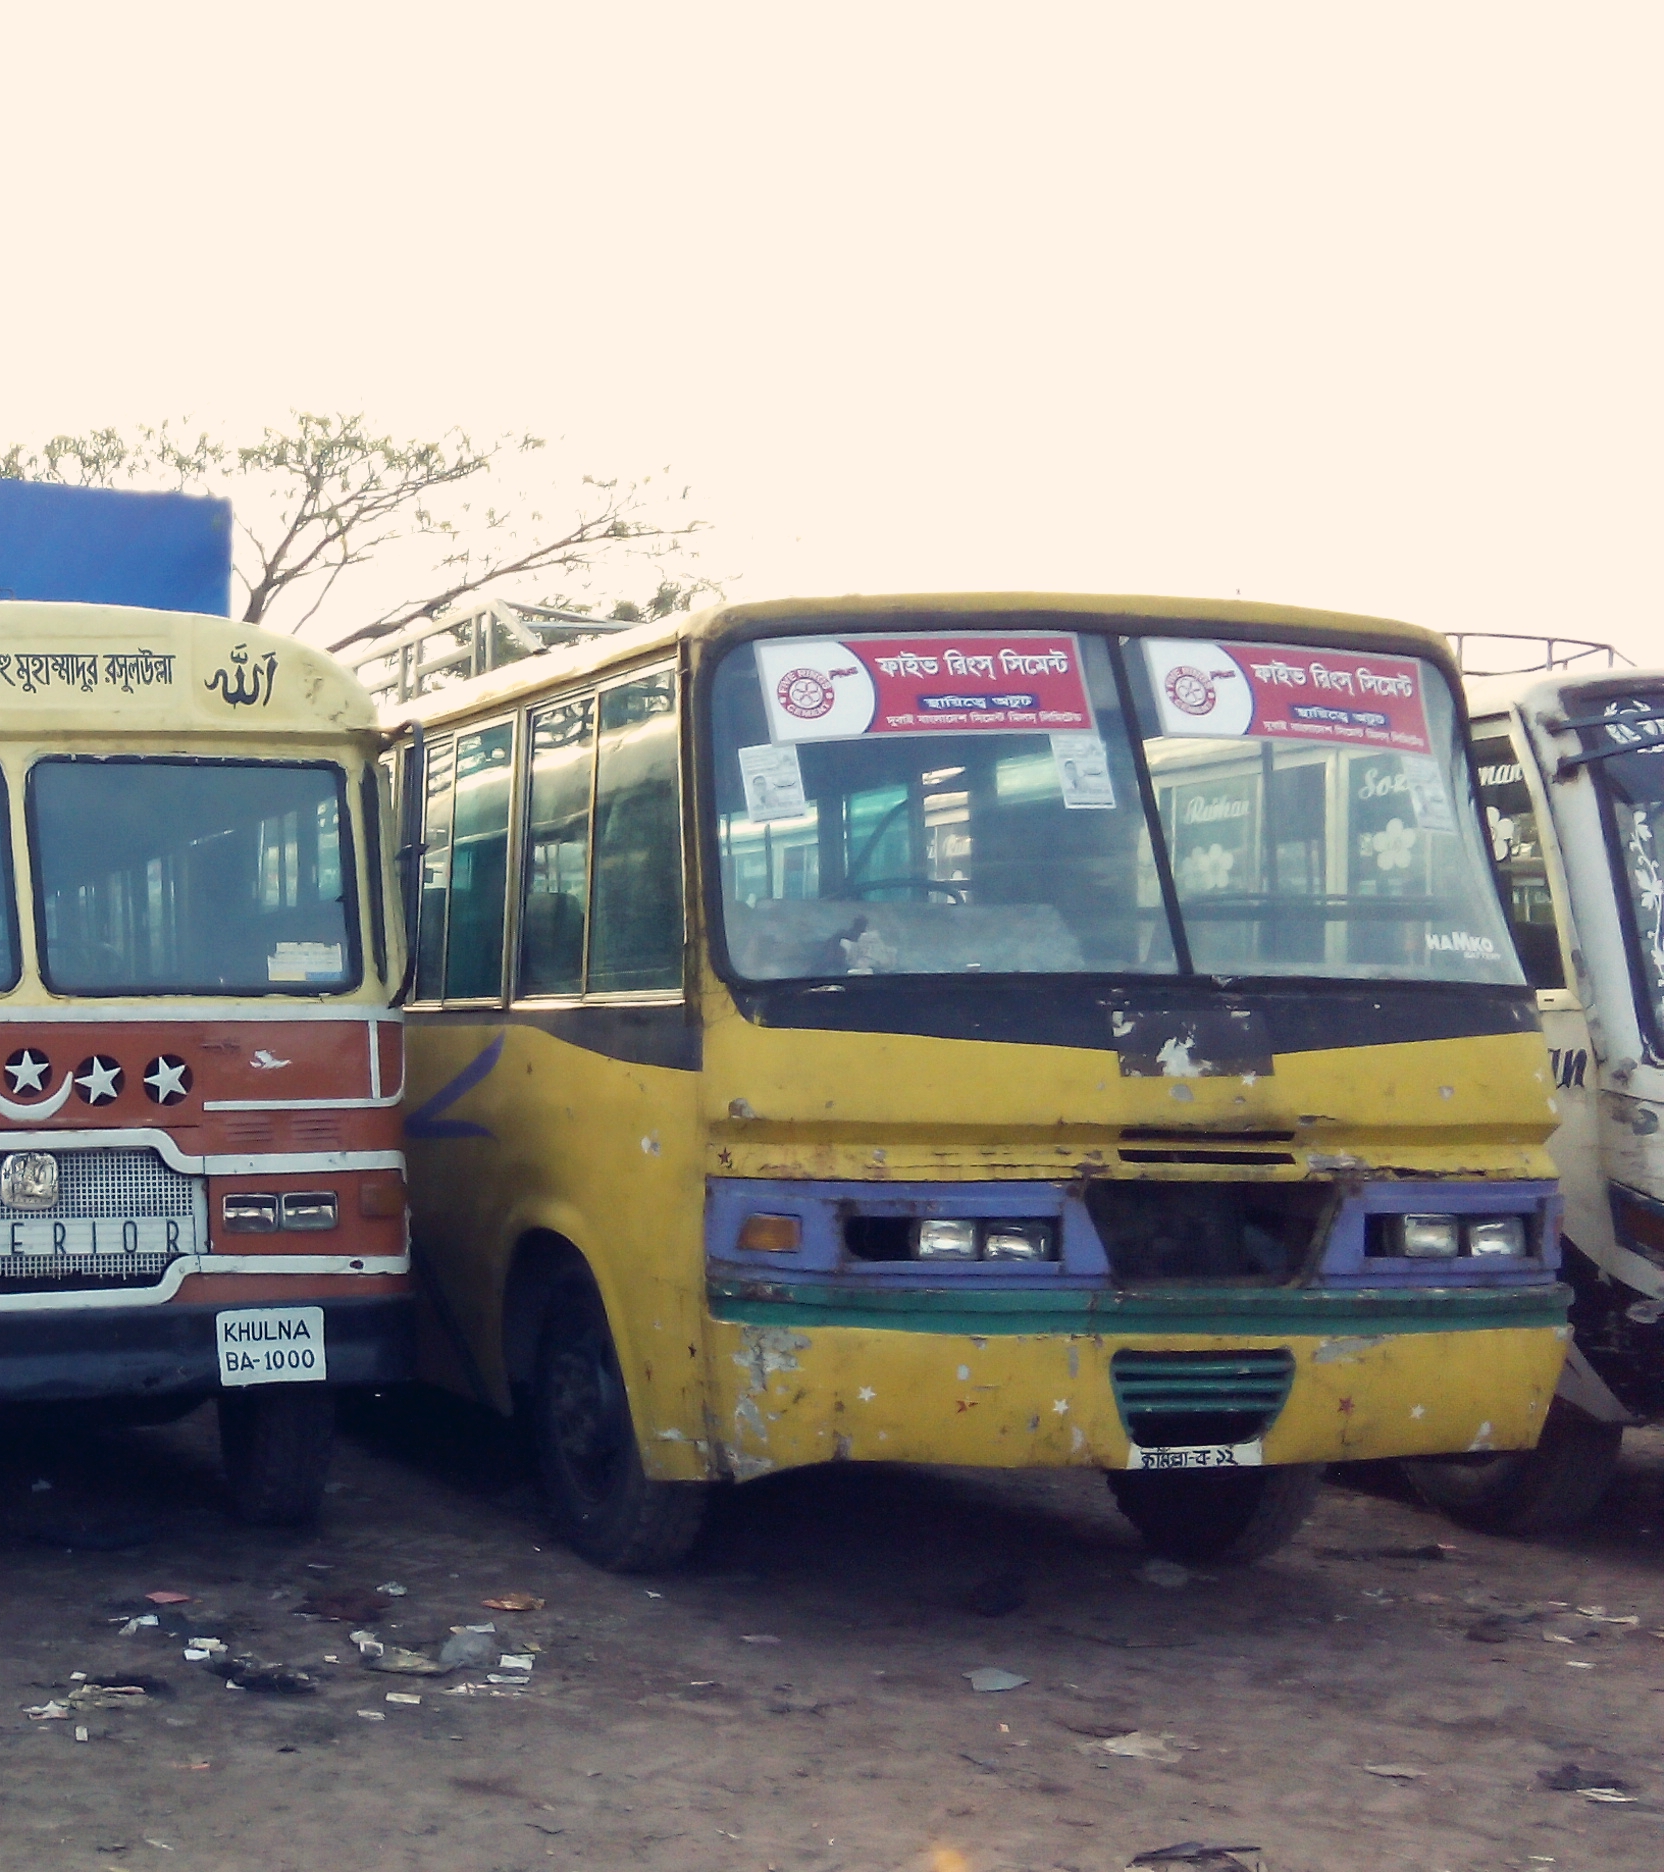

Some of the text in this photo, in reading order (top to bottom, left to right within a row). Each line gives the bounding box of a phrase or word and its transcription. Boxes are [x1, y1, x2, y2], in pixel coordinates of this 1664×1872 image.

[875, 651, 939, 679] ফাইভ
[998, 648, 1069, 676] সিমেন্ট
[1425, 931, 1493, 953] HAMKO
[224, 1319, 311, 1342] KHULNA
[225, 1348, 315, 1372] BA-1000
